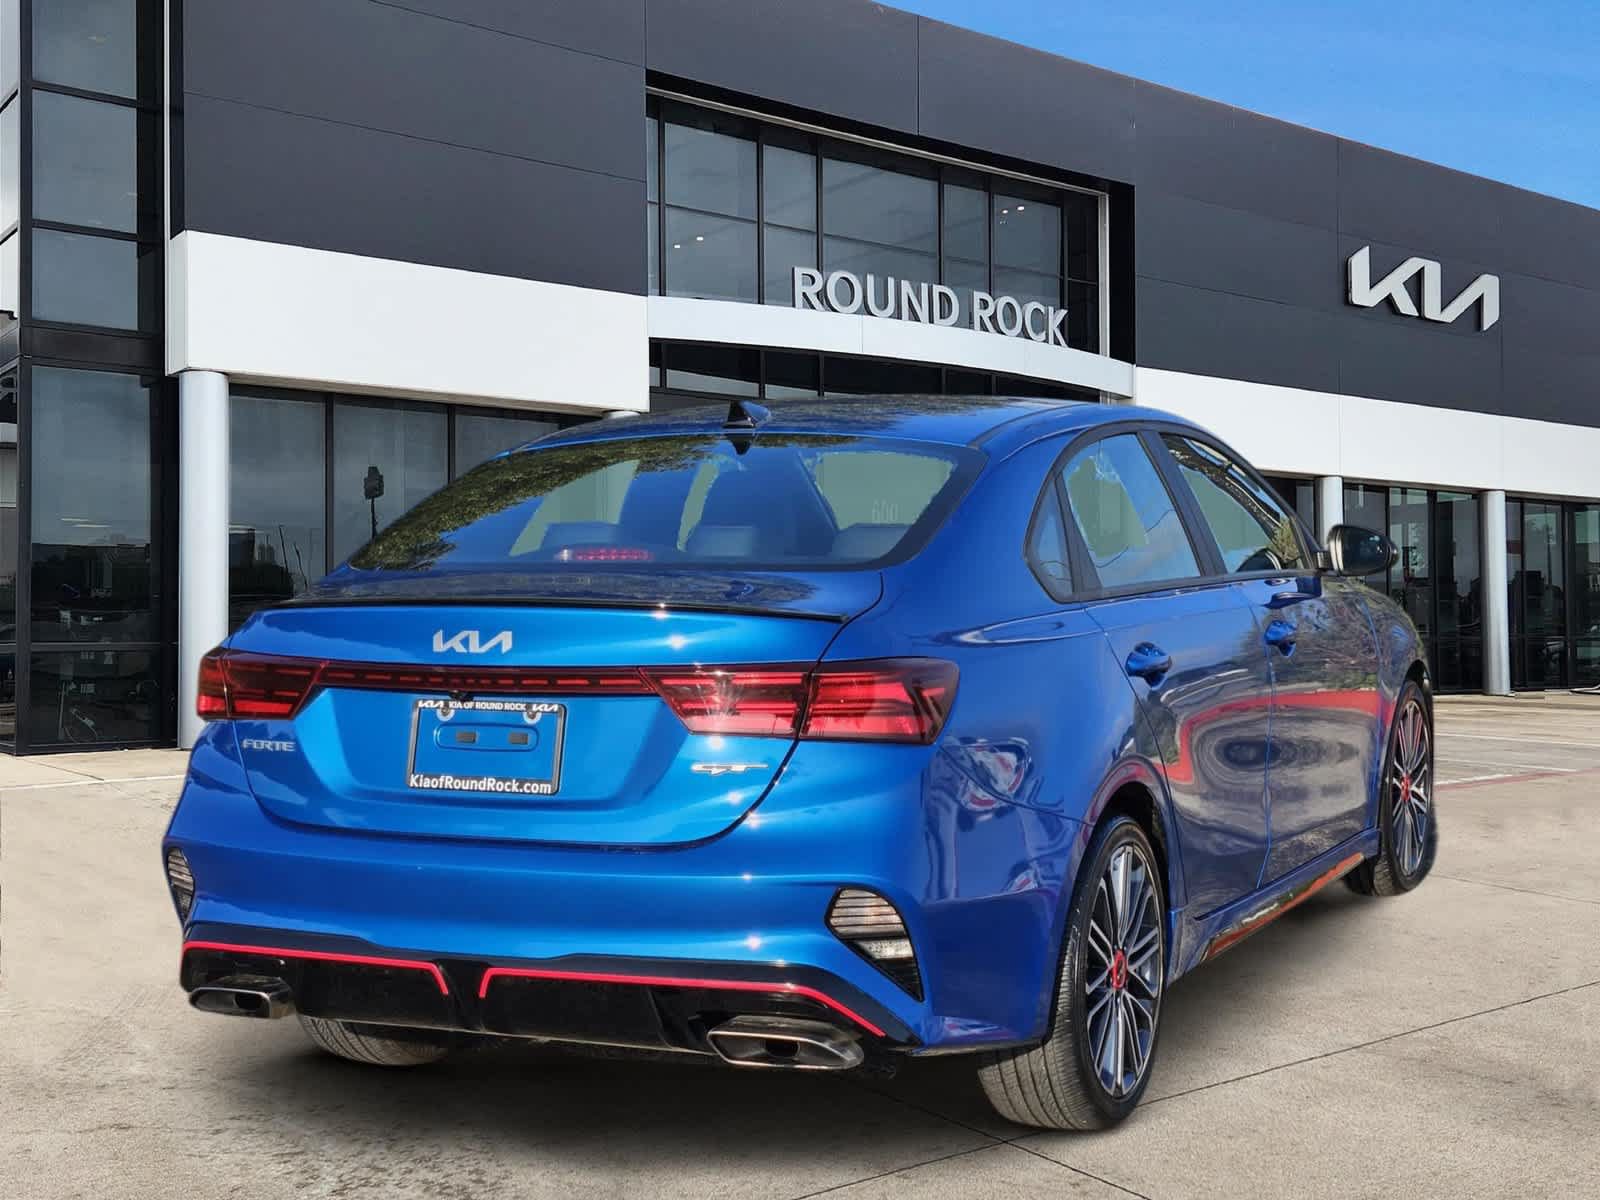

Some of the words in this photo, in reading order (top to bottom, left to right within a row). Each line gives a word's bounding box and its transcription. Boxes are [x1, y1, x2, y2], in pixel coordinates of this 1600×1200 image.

[793, 266, 960, 327] ROUND
[971, 290, 1070, 349] ROCK
[449, 701, 462, 709] KIA
[475, 702, 503, 711] ROUND
[504, 703, 526, 711] ROCK
[243, 738, 296, 752] FORTE
[409, 774, 552, 794] KiaofRoundRock.com
